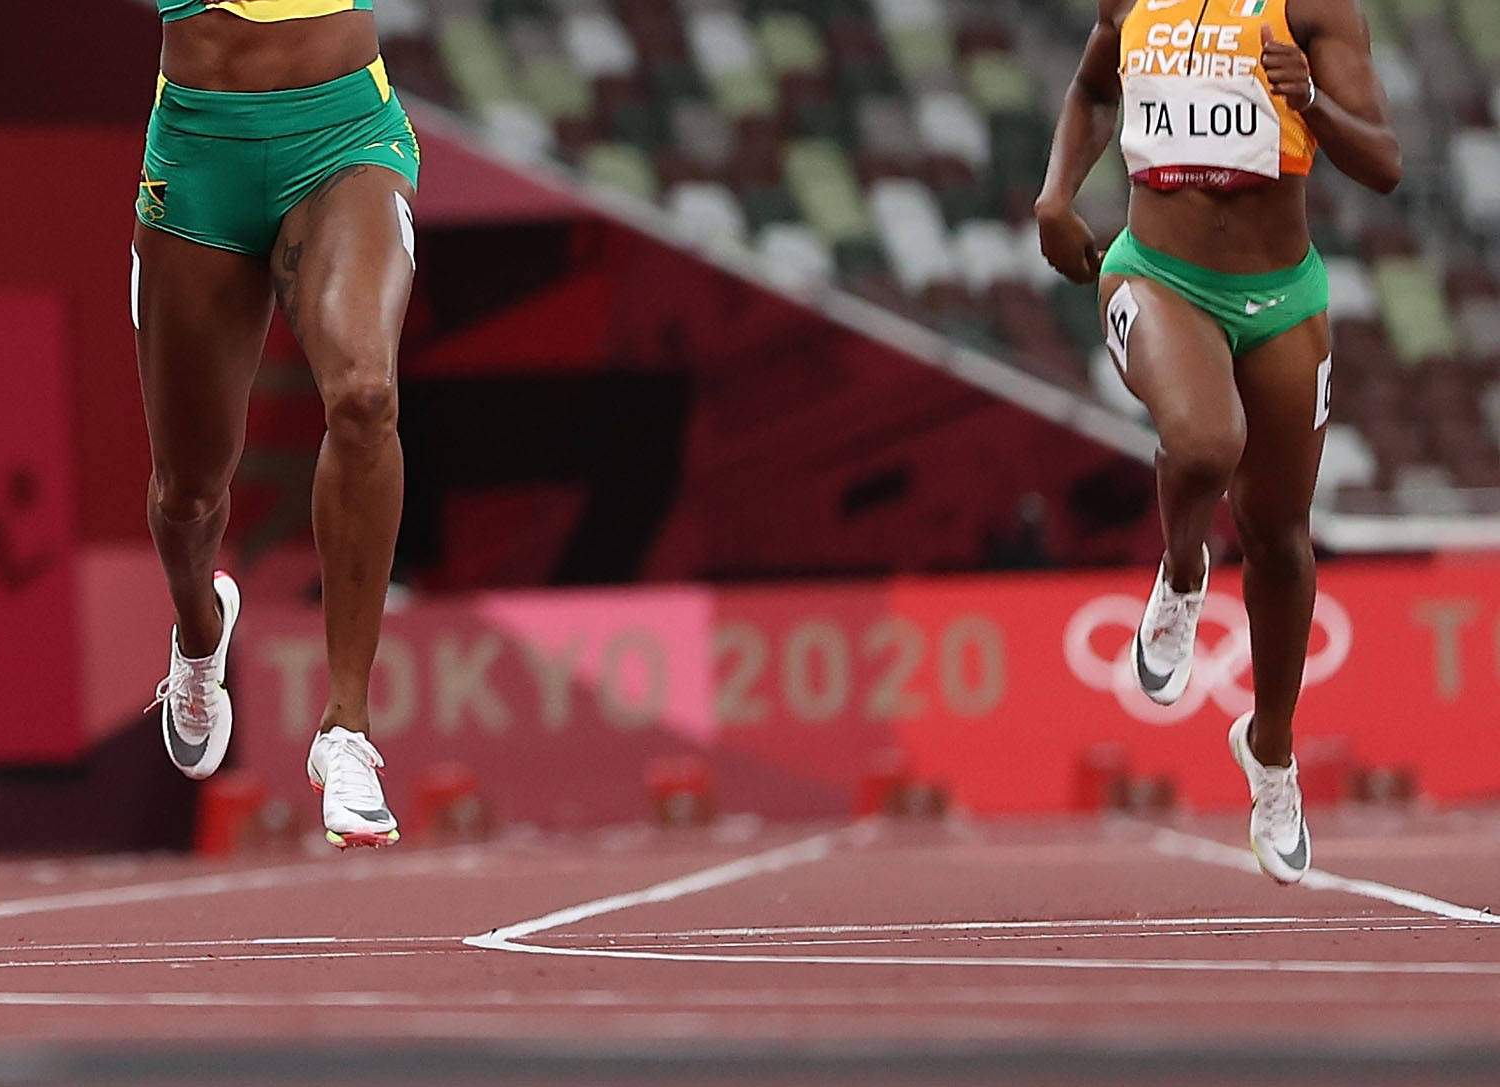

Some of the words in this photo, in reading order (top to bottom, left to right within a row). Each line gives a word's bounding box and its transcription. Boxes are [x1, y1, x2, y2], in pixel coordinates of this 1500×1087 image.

[1147, 20, 1242, 51] CÔTE
[1140, 102, 1173, 136] TA
[1189, 103, 1257, 136] LOU
[260, 626, 668, 740] TOKYO
[711, 615, 1006, 724] 2020
